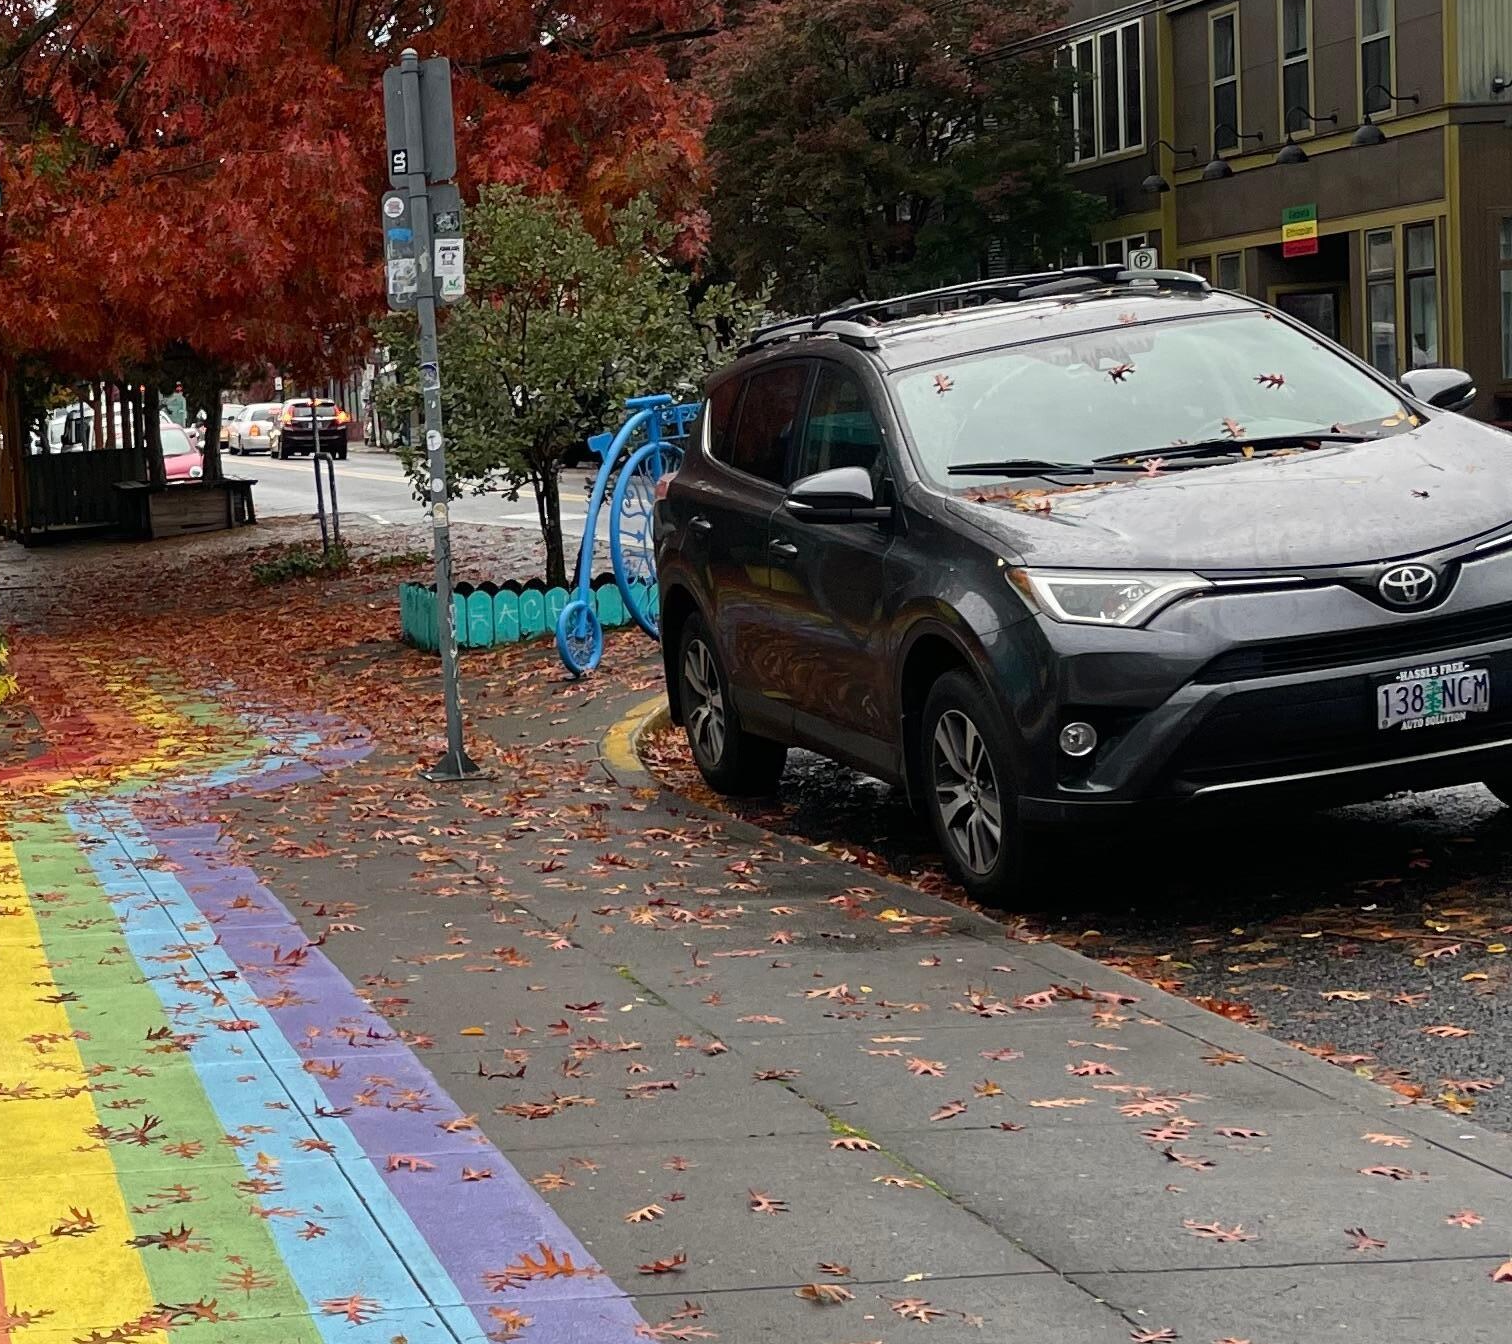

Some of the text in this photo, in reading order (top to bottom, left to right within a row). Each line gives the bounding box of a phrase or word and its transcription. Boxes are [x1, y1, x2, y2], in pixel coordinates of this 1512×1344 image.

[1399, 661, 1465, 682] HASSLE FREE
[1382, 673, 1488, 719] 138 NCM
[1400, 718, 1424, 731] AUTO
